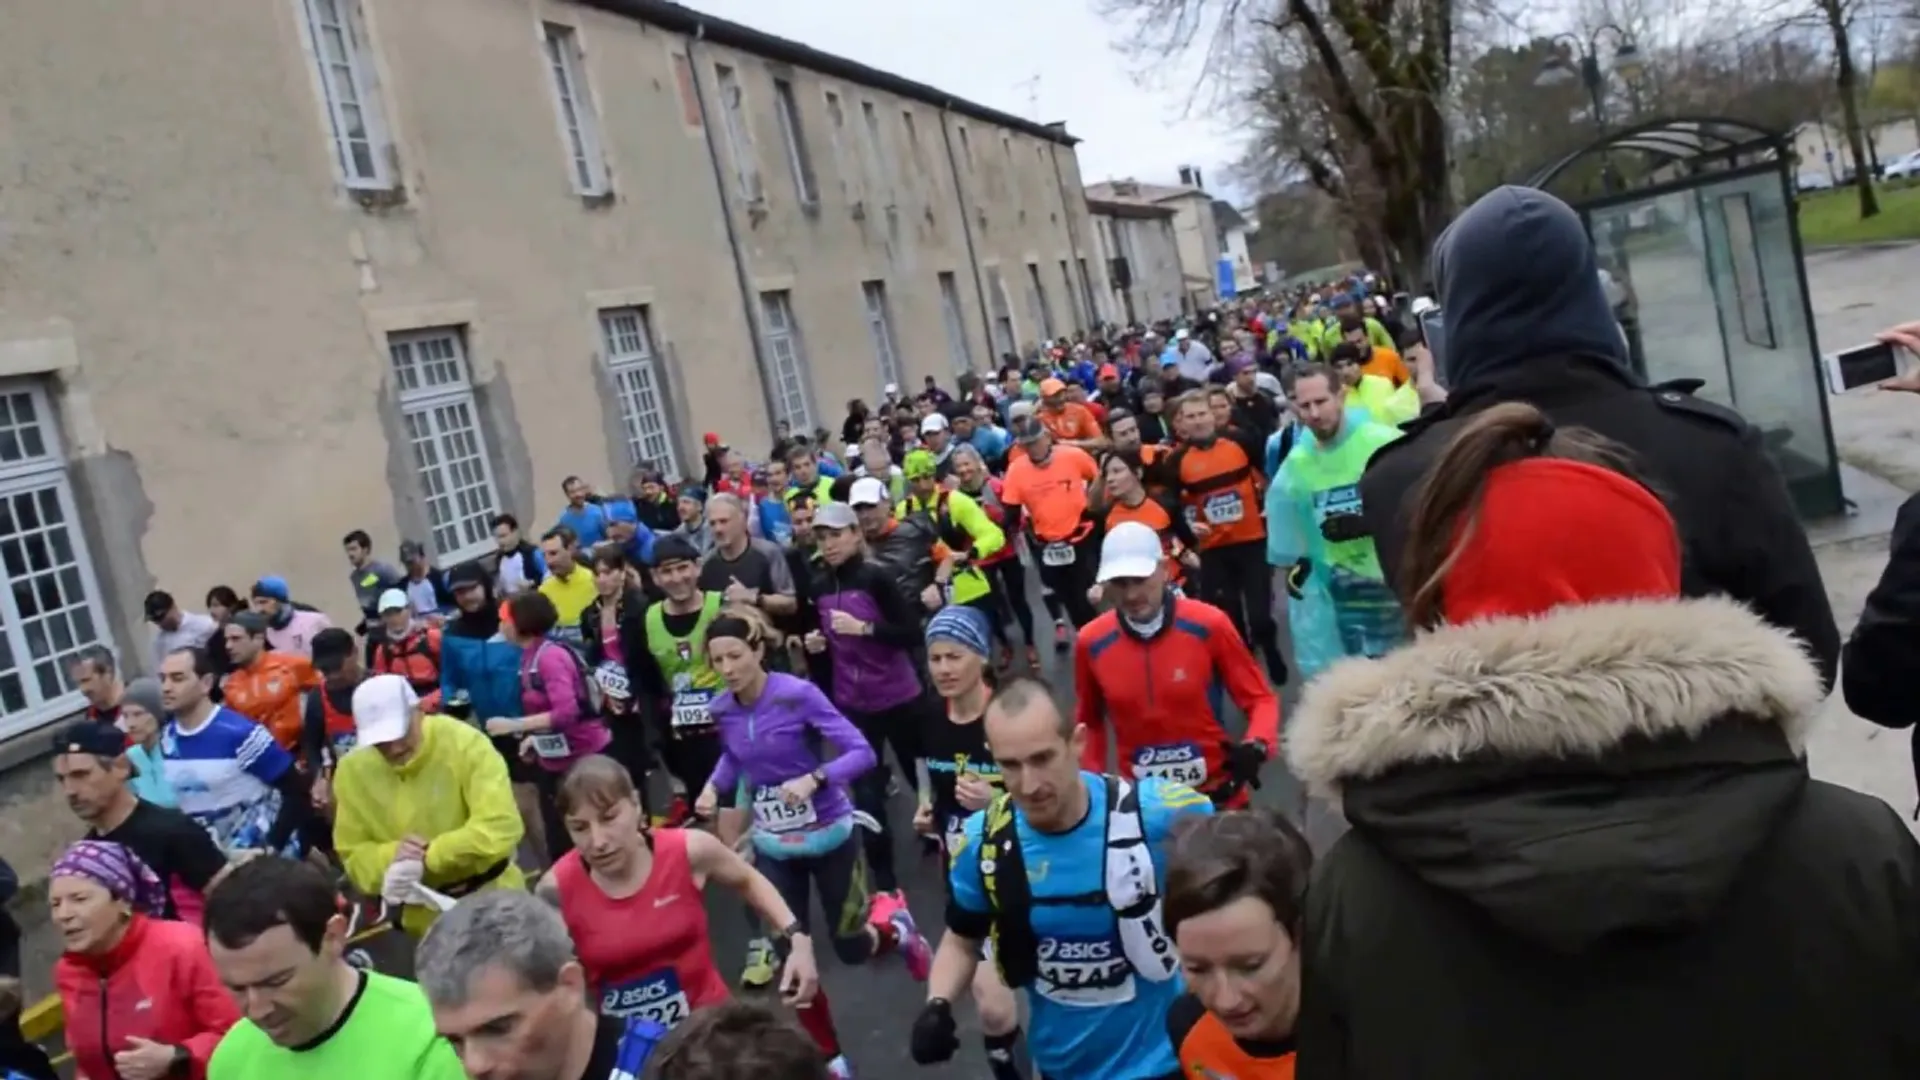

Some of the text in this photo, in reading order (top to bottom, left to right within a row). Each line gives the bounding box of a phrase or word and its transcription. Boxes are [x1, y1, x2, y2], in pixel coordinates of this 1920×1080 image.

[1155, 745, 1193, 762] asics
[1058, 940, 1111, 959] asics
[622, 979, 667, 1006] asics
